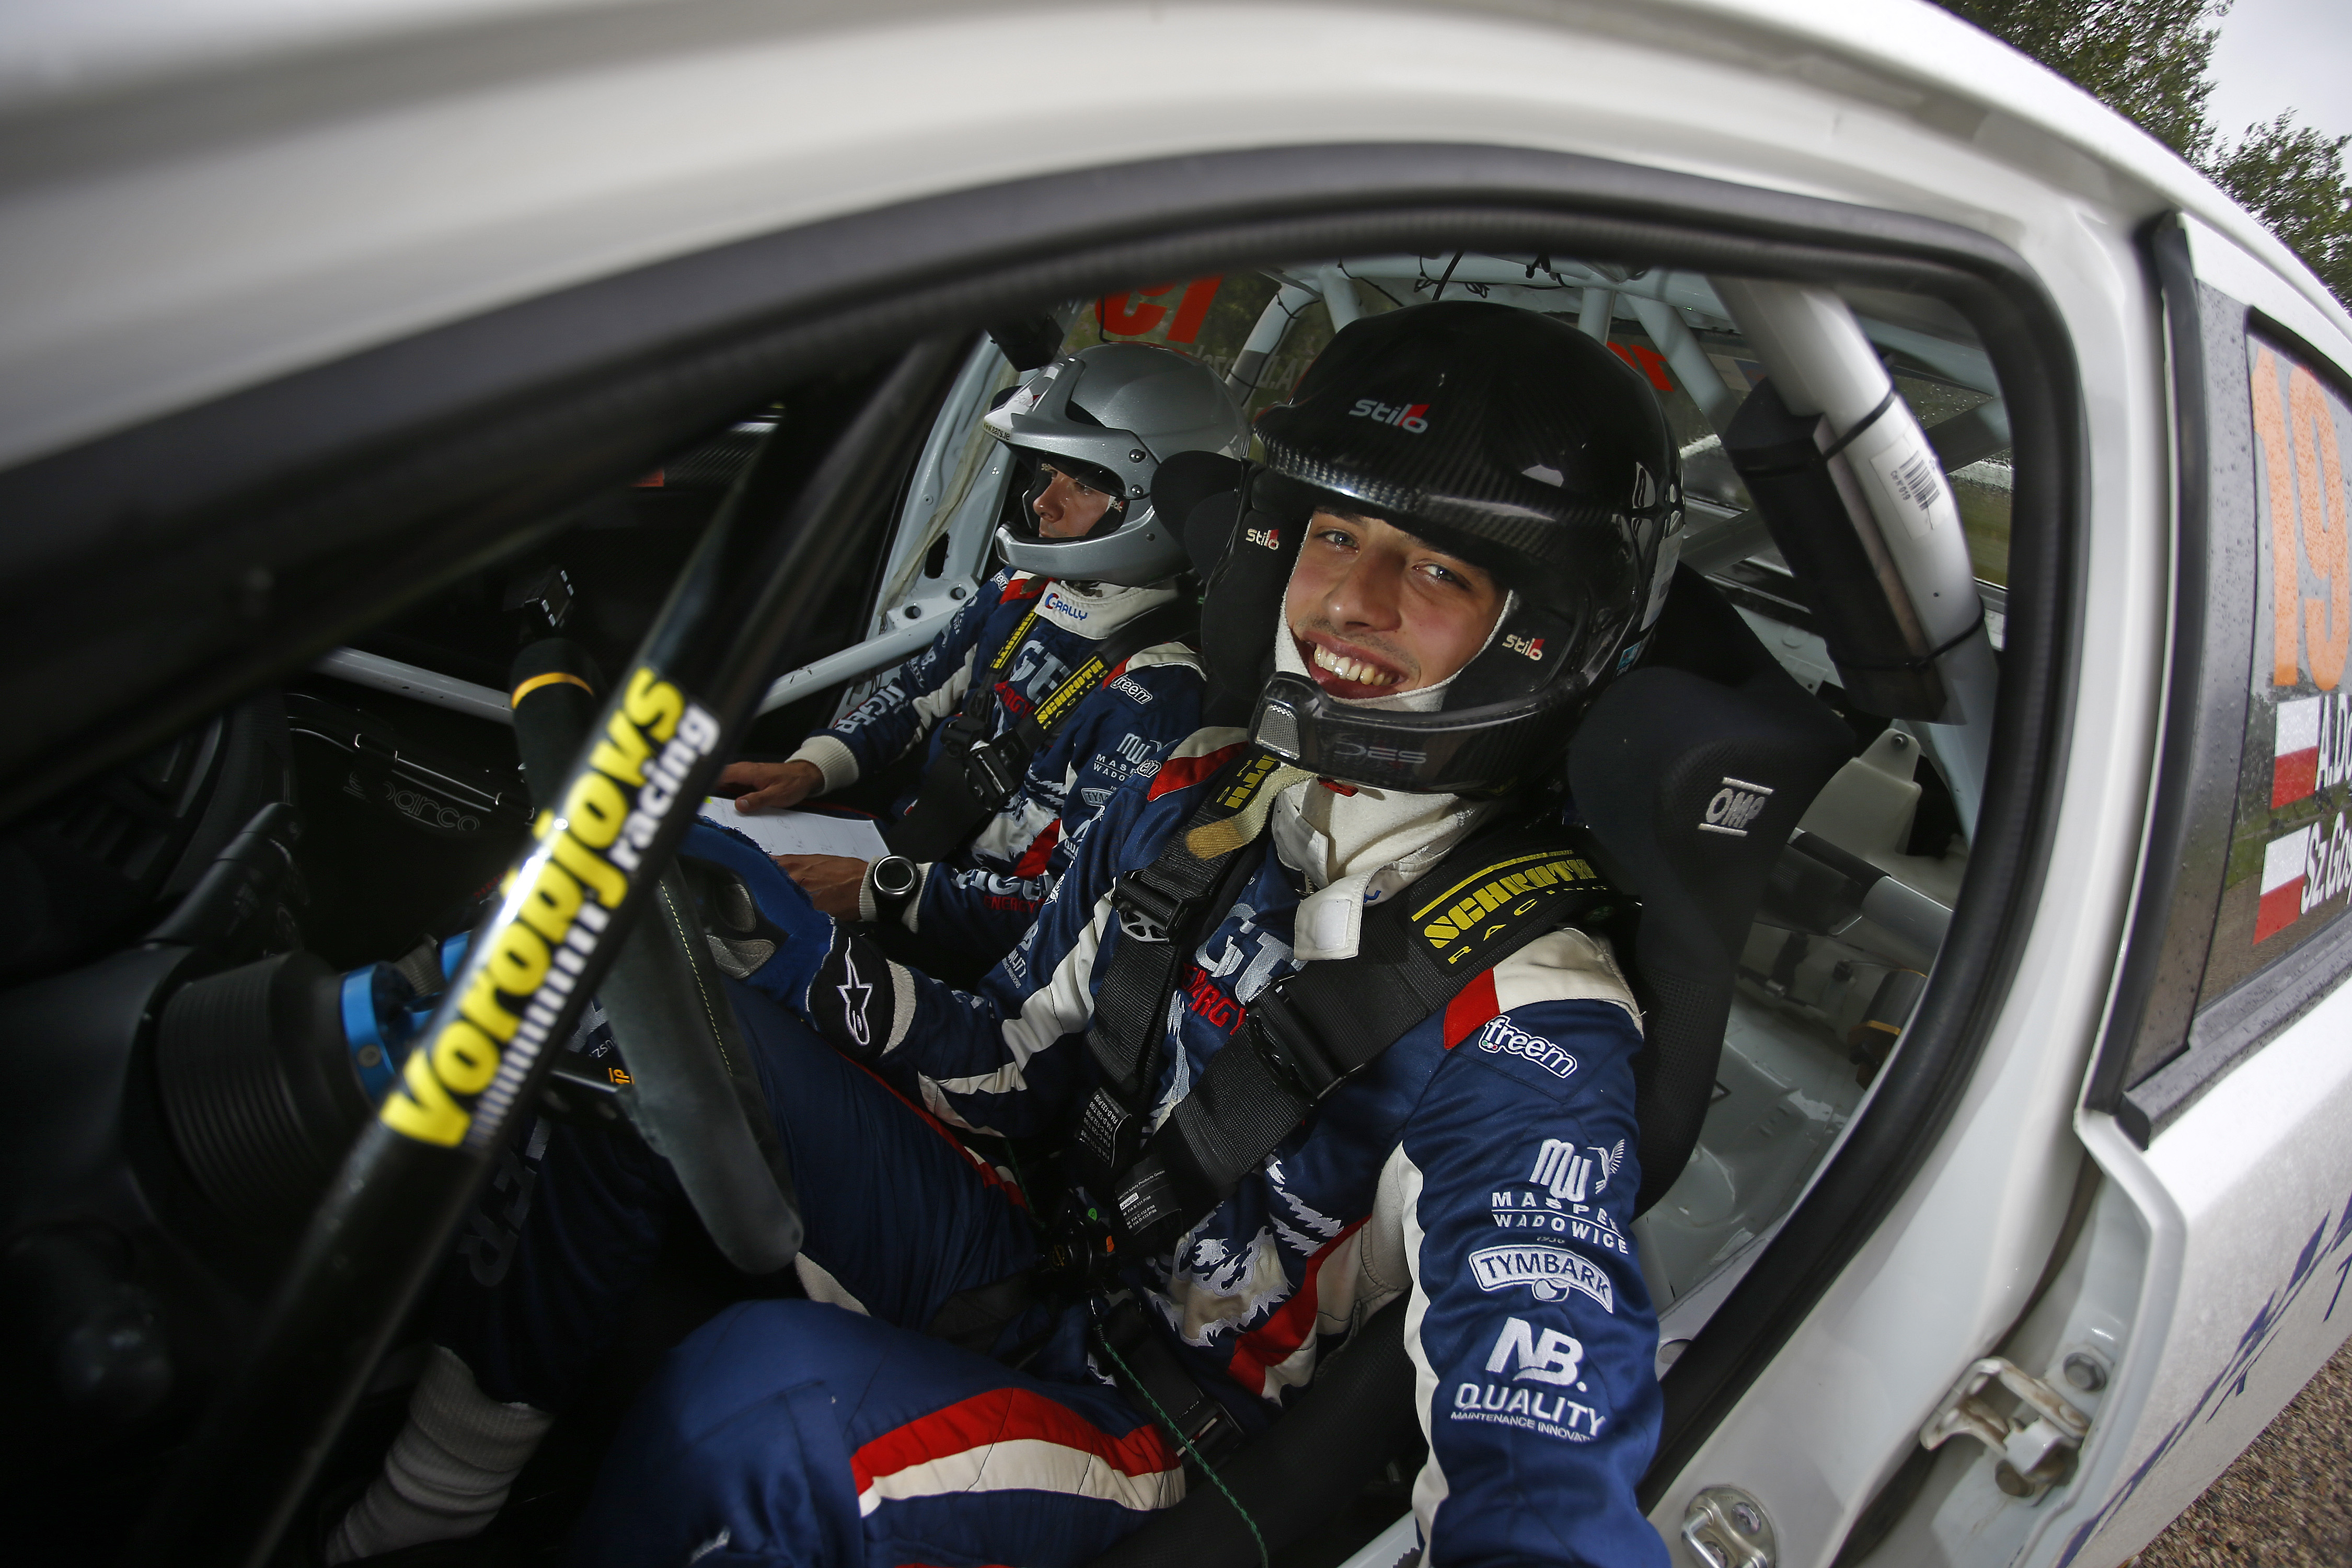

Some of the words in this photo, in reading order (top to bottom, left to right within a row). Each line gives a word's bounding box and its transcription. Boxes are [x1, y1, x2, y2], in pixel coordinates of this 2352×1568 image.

[1349, 398, 1431, 434] Stilo
[1899, 486, 1911, 501] 019
[1245, 527, 1280, 550] Stilo
[2252, 347, 2348, 691] 19
[1044, 593, 1088, 621] C-RALLY
[1502, 633, 1545, 661] Stilo
[1036, 660, 1105, 725] SCHROTH
[609, 702, 721, 872] racing
[1705, 787, 1766, 834] OMP
[1423, 858, 1598, 949] SCHROTH
[1483, 1016, 1576, 1077] freem
[1492, 1214, 1629, 1254] WADOWICE
[1480, 1253, 1609, 1300] TYMBARK
[1450, 1411, 1536, 1430] MAINTENANCE
[1454, 1382, 1606, 1438] QUALITY
